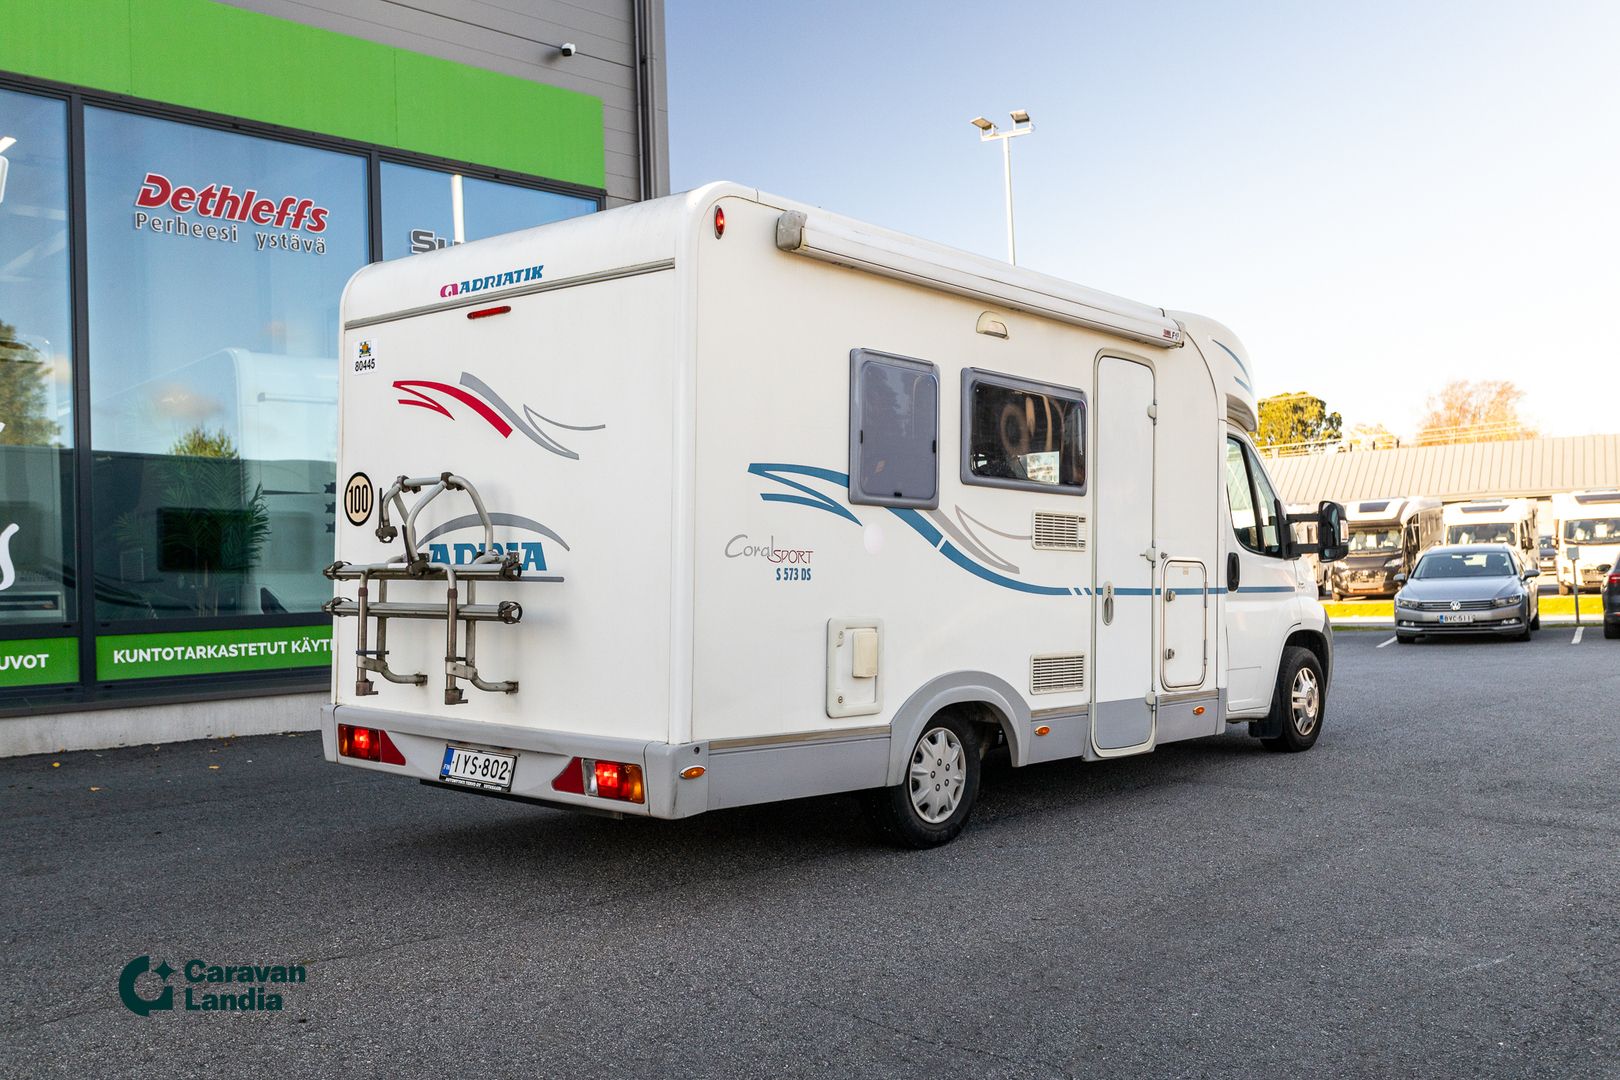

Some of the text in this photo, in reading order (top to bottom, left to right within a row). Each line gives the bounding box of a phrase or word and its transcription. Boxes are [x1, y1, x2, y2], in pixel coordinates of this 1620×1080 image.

[136, 172, 329, 233] Dethleffs
[135, 212, 327, 255] Perheesi ystävä
[459, 265, 544, 294] ADRIATIK
[355, 358, 375, 371] 80445
[349, 485, 368, 514] 100
[725, 534, 813, 564] Coral SPORT
[776, 568, 811, 580] S 573 DS
[113, 641, 287, 664] KUNTOTARKASTETUT
[454, 753, 509, 780] IYS-802
